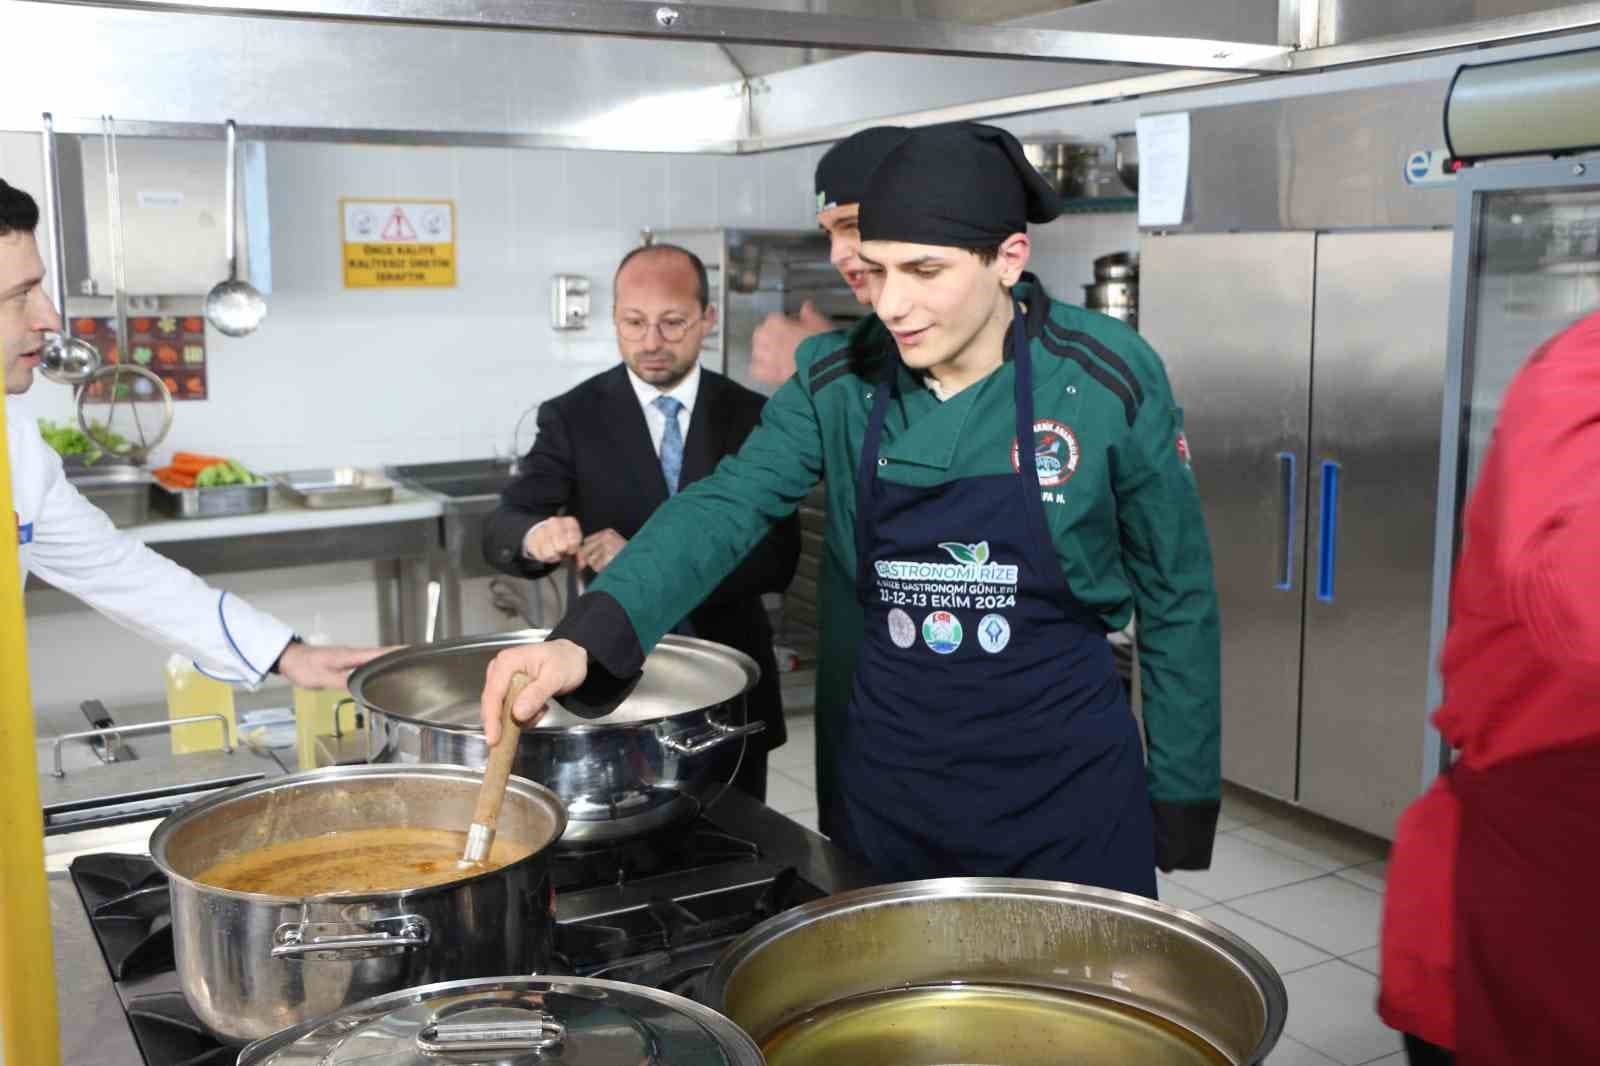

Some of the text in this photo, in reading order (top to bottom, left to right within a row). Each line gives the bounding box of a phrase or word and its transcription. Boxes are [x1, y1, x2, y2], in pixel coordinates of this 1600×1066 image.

[876, 561, 1016, 582] GASTRONOMİ RİZE
[880, 588, 1016, 609] 11-12-13 EKİM 2024
[902, 582, 967, 594] GASTRONOMİ
[968, 583, 1017, 594] GÜNLERİ
